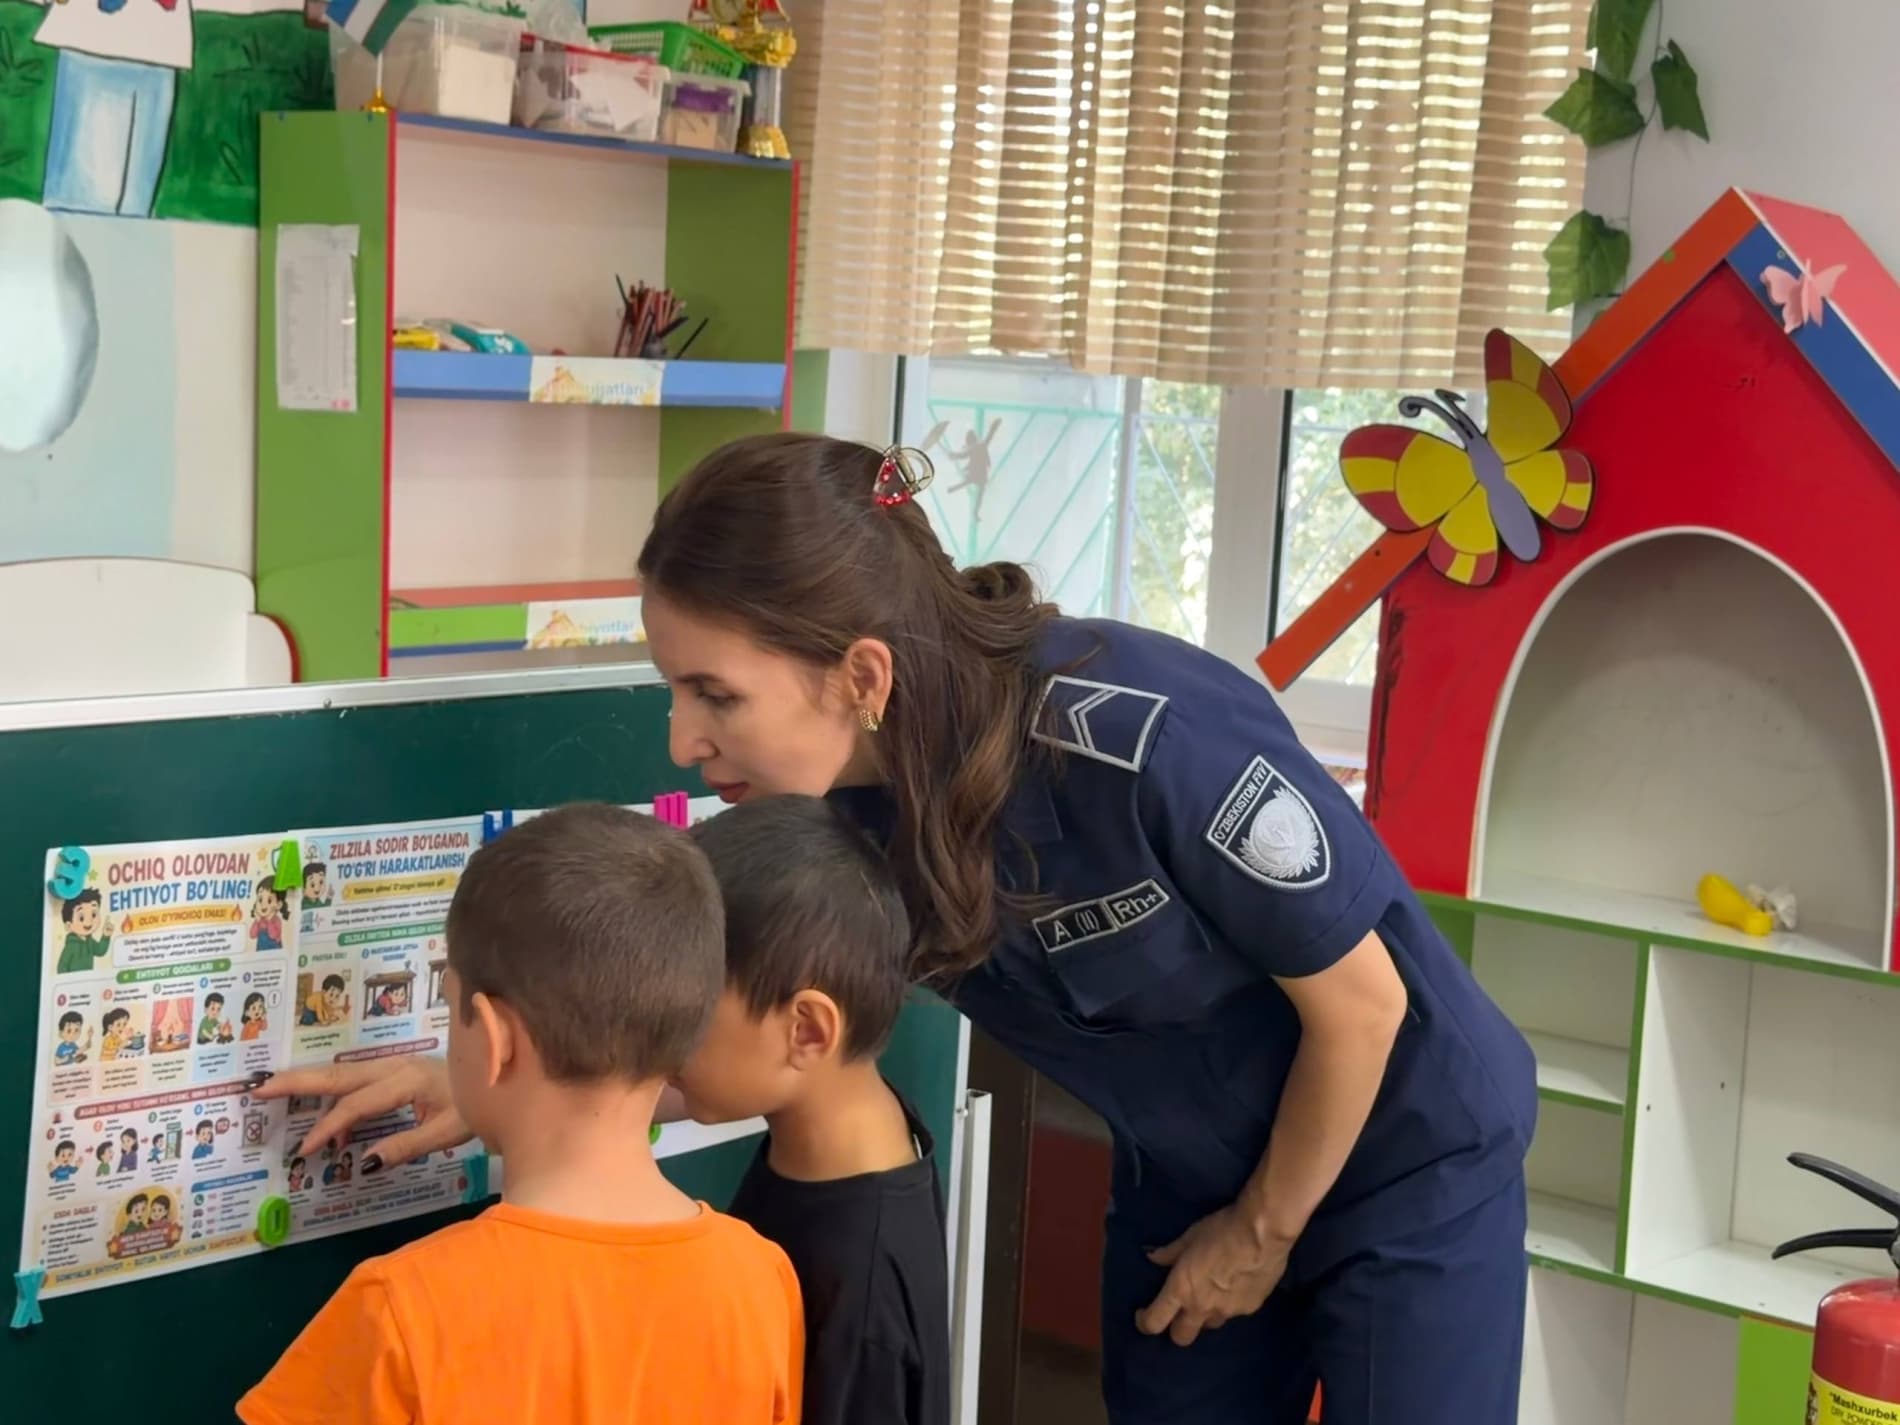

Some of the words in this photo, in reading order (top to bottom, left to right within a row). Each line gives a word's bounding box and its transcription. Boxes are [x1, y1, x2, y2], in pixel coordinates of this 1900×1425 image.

[1214, 781, 1258, 840] O'ZBEKISTON
[330, 840, 371, 860] ZILZILA
[376, 836, 408, 855] SODIR
[108, 857, 165, 886] OCHIQ
[172, 853, 250, 877] OLOVDAN
[337, 861, 376, 879] TO'G'RI
[379, 853, 465, 875] HARAKATLANISH
[109, 883, 181, 912] EHTIYOT
[186, 879, 253, 901] BO'LING!
[1054, 920, 1073, 942] A
[1112, 893, 1157, 920] Rh+
